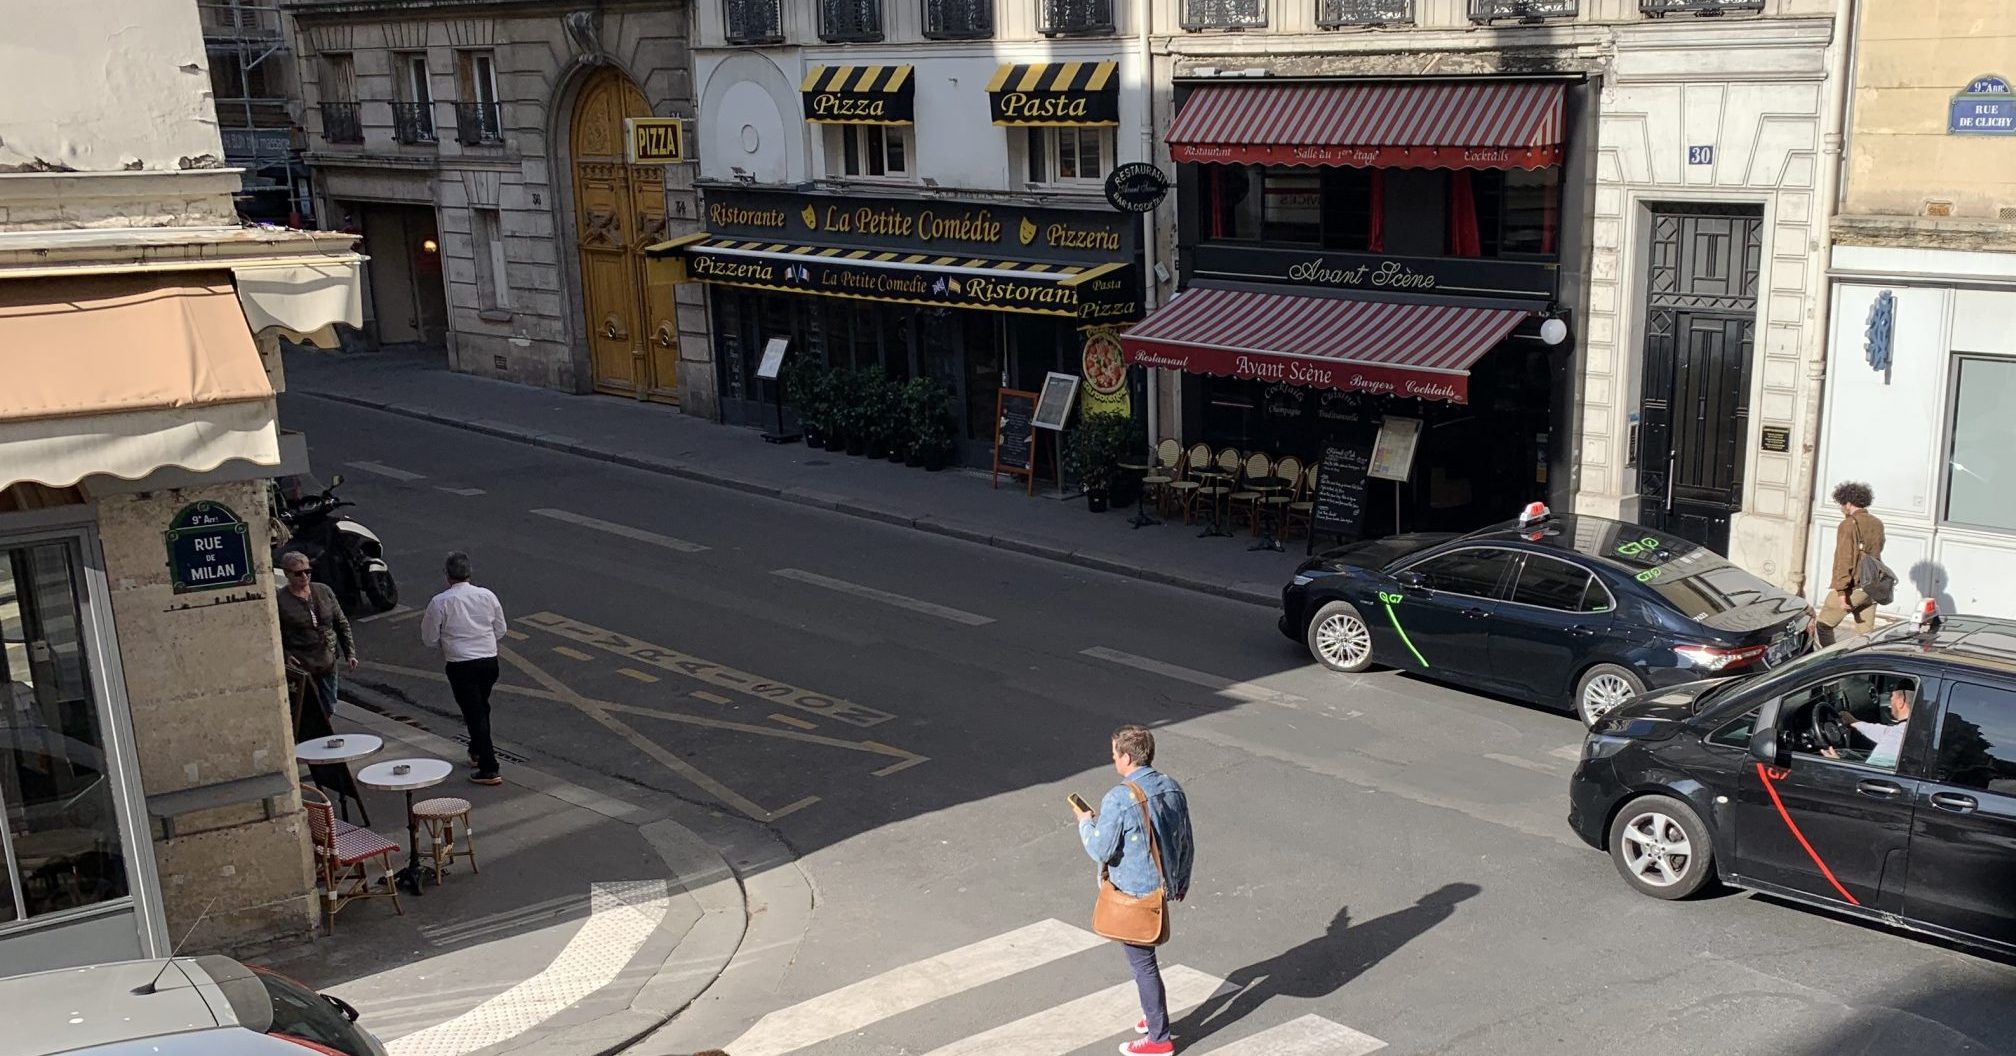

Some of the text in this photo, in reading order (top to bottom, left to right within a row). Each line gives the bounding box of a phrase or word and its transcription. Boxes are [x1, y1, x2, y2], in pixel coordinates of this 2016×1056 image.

[813, 93, 885, 116] Pizza
[1001, 92, 1087, 117] Pasta
[1975, 105, 1998, 114] RUE
[1960, 117, 2013, 127] DE CLICHY
[638, 127, 676, 156] PIZZA
[1184, 145, 1232, 157] Restaurant
[1296, 147, 1317, 159] Salle
[1464, 148, 1509, 161] Cocktails
[1691, 147, 1710, 164] 30
[710, 202, 785, 227] Ristorante
[824, 205, 1000, 243] La Petite Comédie
[1046, 223, 1120, 250] Pizzeria
[694, 256, 774, 280] Pizzeria
[1289, 257, 1435, 288] Avant Scène
[822, 269, 837, 285] La
[841, 271, 876, 290] Petite
[1092, 279, 1122, 291] Pasta
[1079, 300, 1136, 319] Pizza
[1134, 350, 1189, 367] Restaurant
[1236, 355, 1332, 384] Avant Scène
[1350, 374, 1455, 397] Burgers Cocktails
[194, 536, 223, 551] RUE
[206, 554, 216, 562] DE
[191, 563, 235, 580] MILAN
[1389, 594, 1403, 603] G7
[526, 615, 884, 725] LIVRAISON
